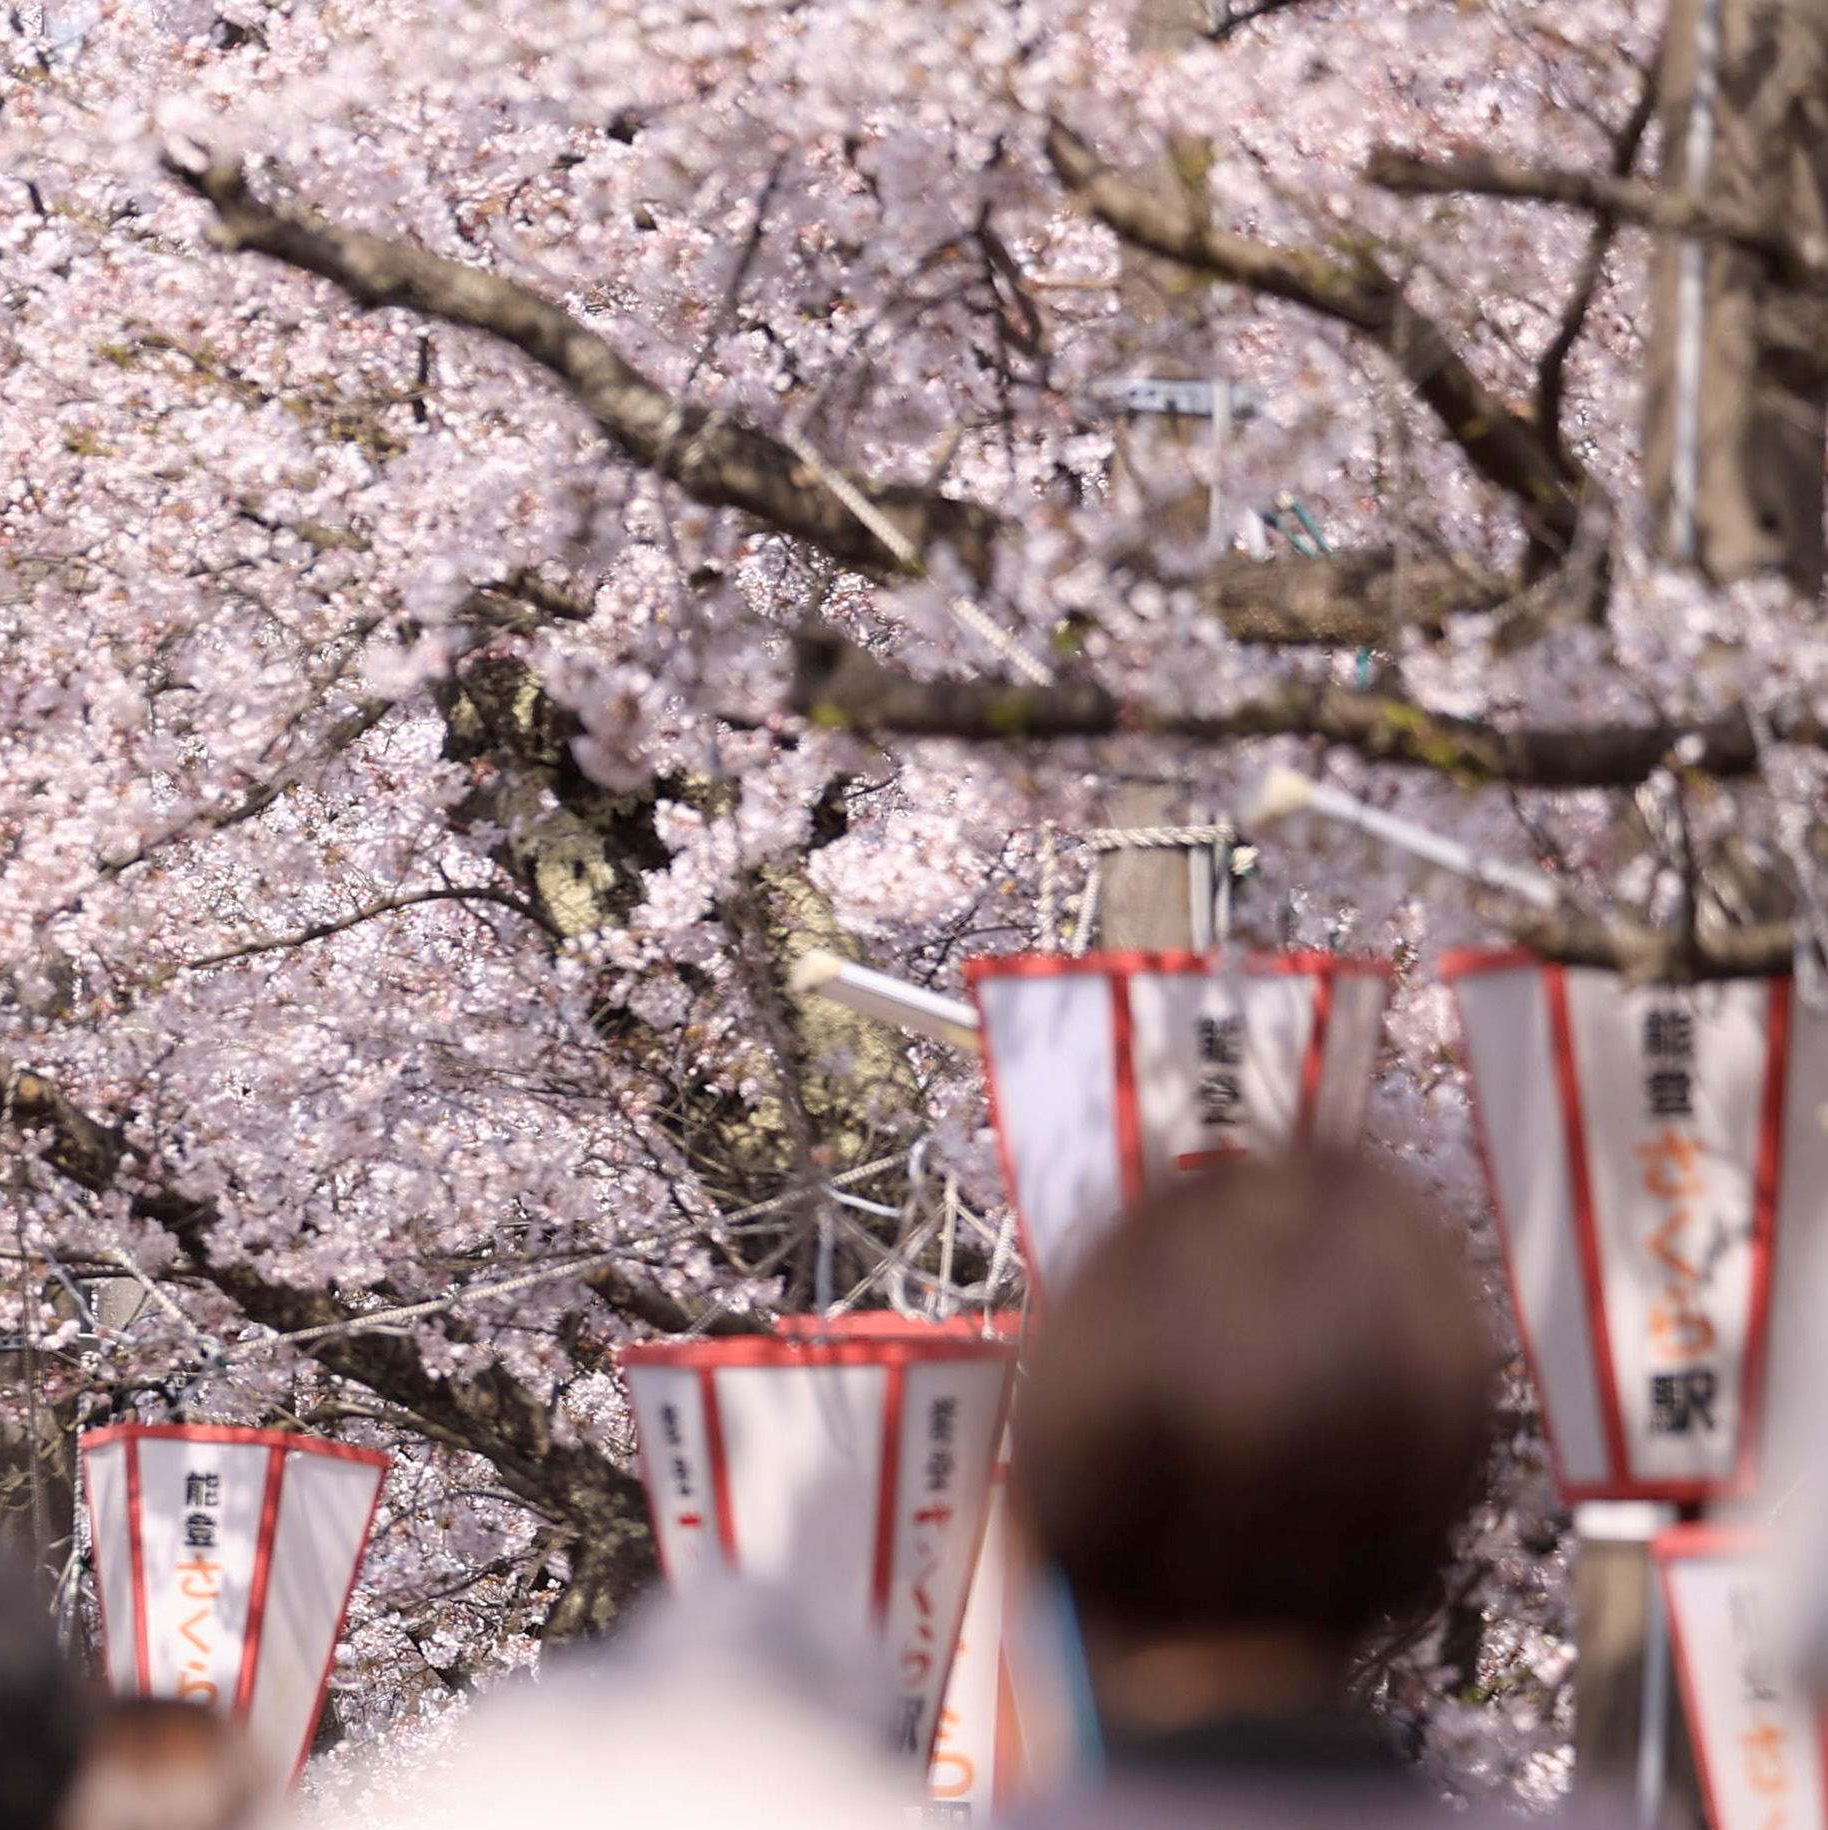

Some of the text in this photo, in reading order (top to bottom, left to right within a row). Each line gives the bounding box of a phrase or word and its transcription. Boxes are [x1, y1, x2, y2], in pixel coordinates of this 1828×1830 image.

[1637, 1008, 1717, 1434] 能登さくら駅
